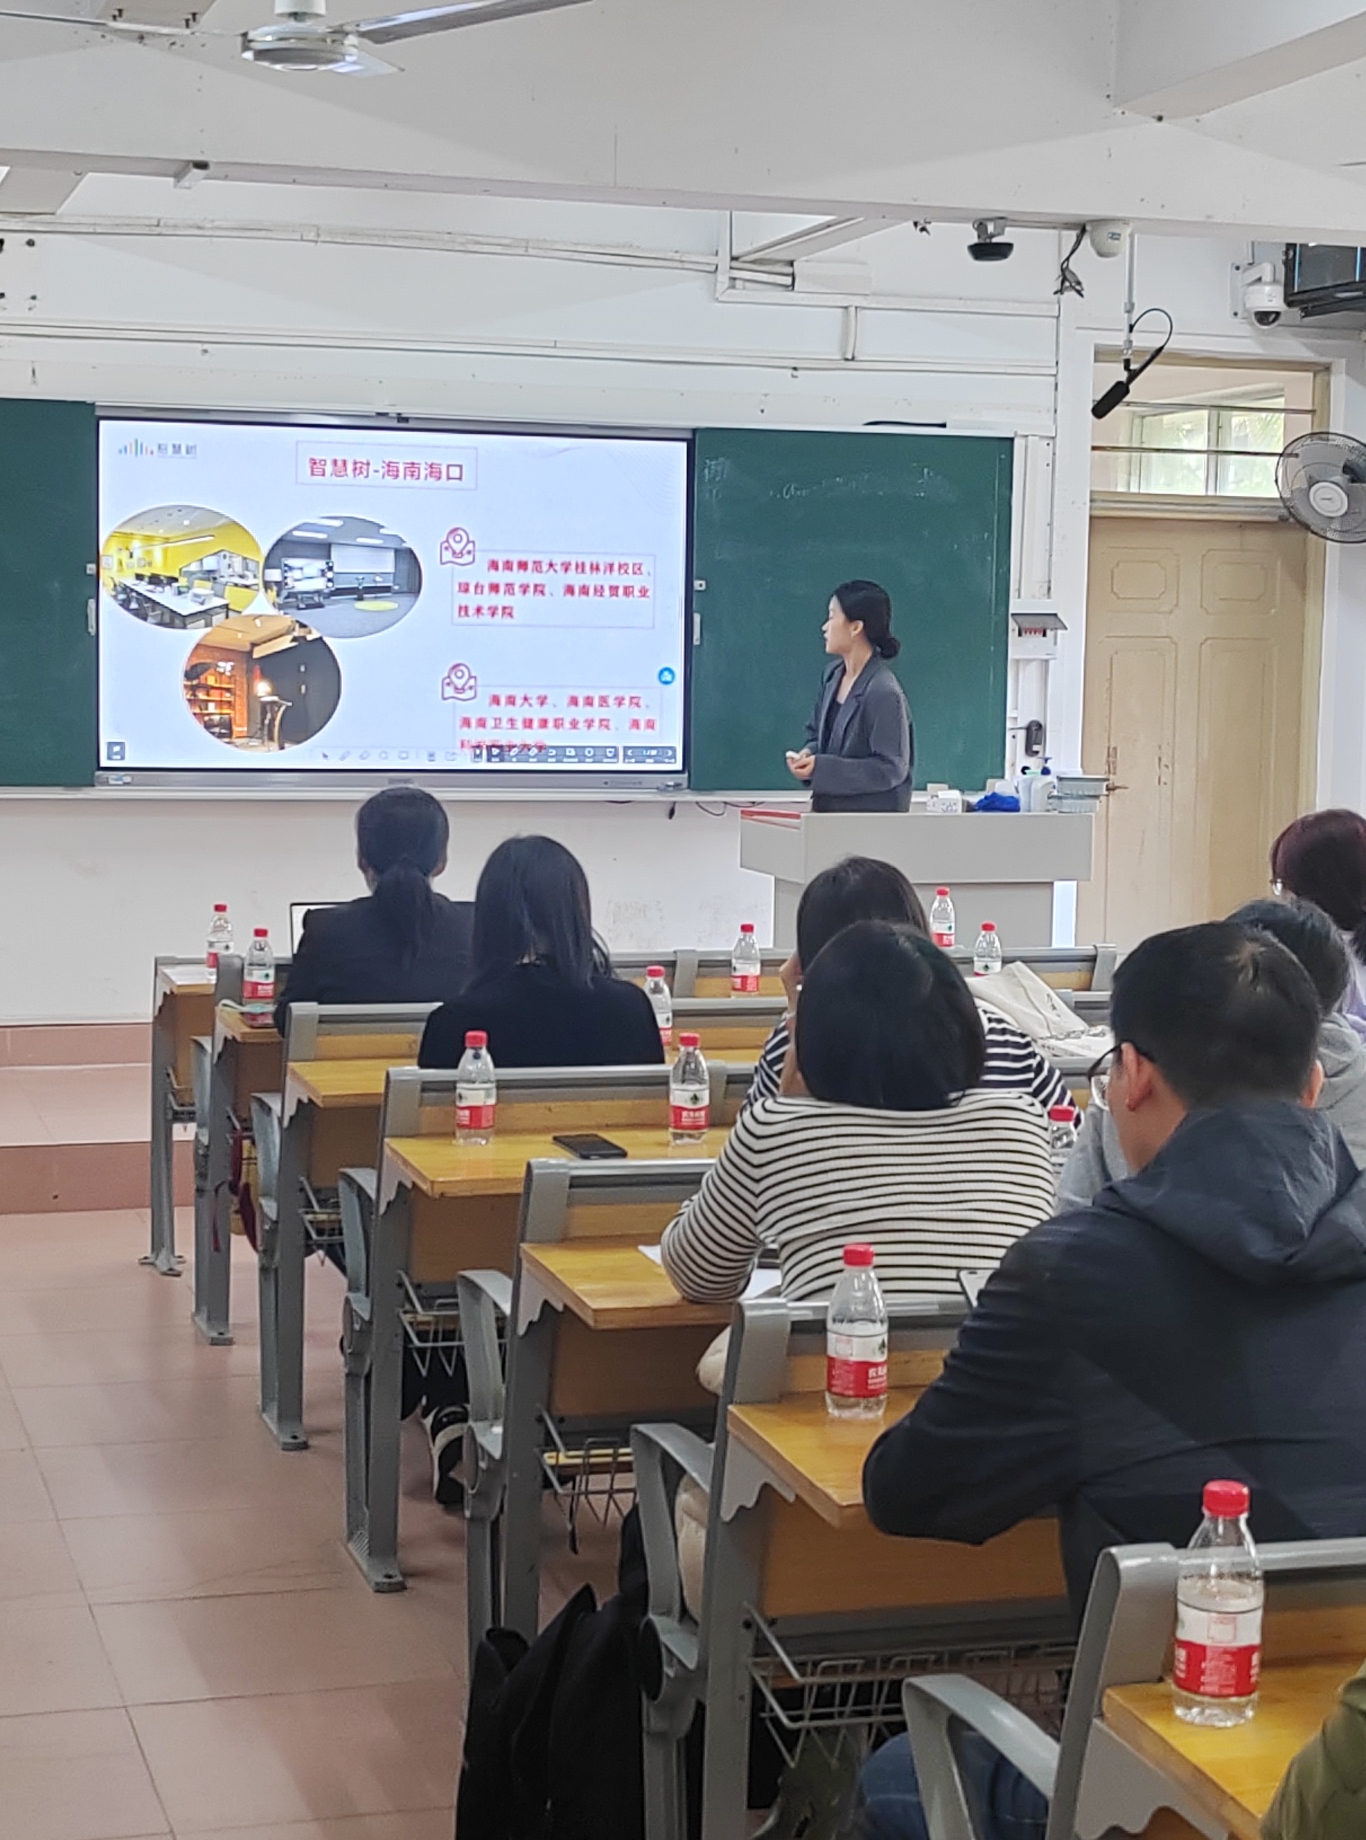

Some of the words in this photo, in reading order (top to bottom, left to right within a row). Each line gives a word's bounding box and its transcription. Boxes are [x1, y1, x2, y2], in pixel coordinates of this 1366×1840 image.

[308, 457, 464, 482] 智慧树-海南海口
[458, 603, 514, 619] 技术学院
